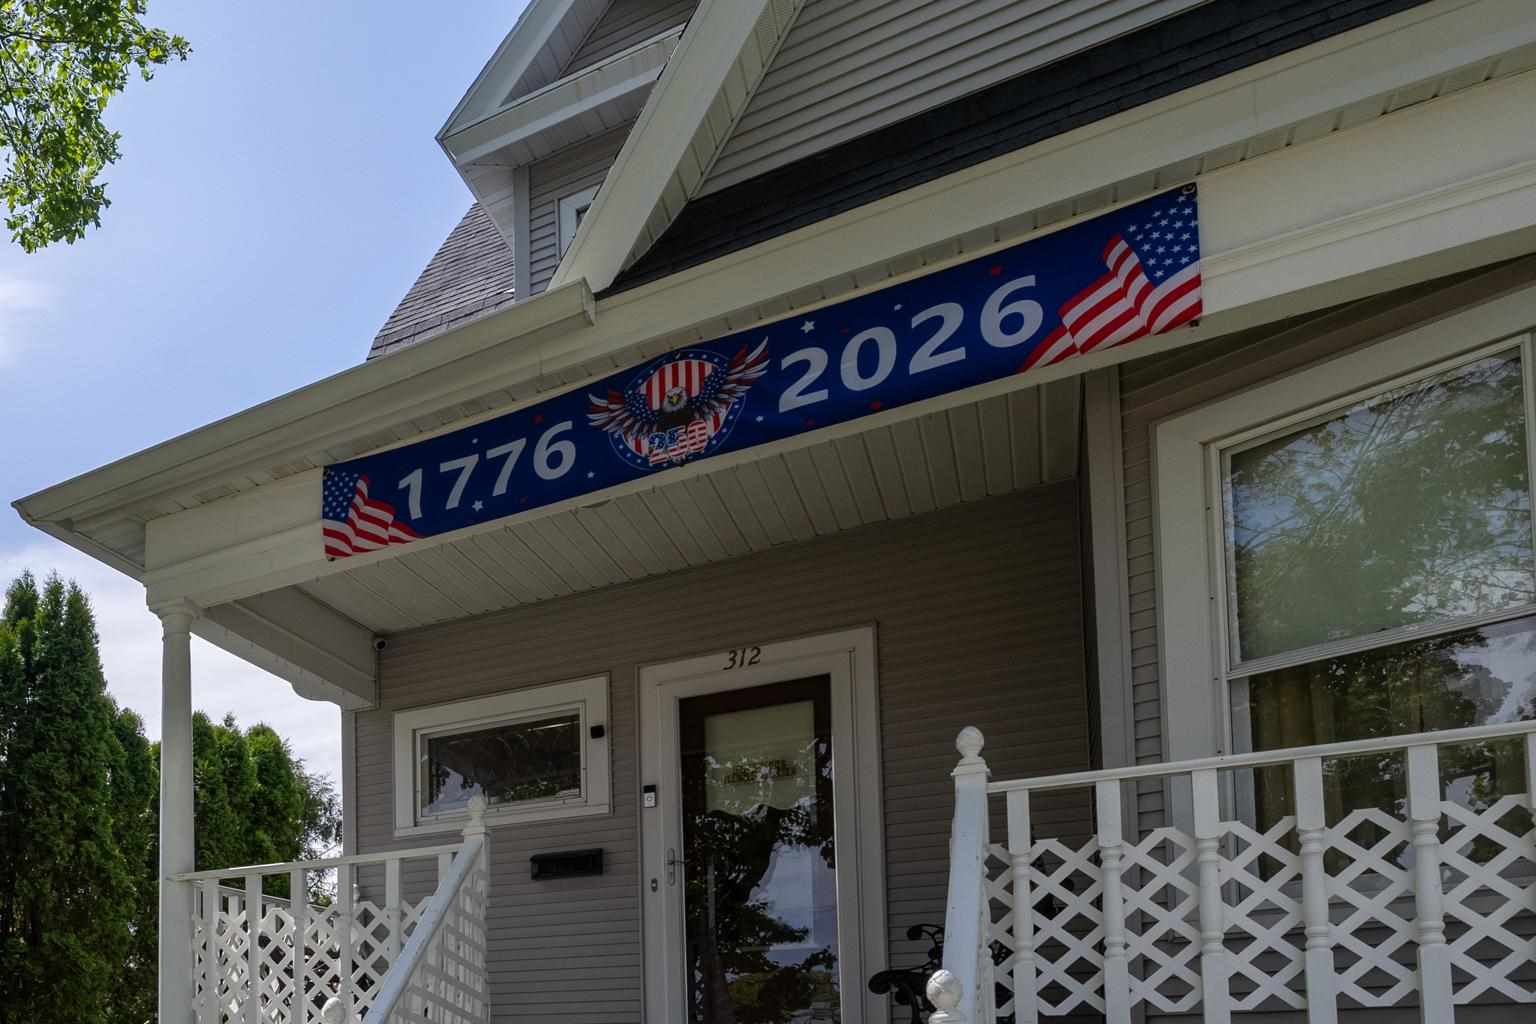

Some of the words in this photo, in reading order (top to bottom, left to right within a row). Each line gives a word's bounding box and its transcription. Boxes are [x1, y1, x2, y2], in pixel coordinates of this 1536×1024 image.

[398, 421, 576, 520] 1776
[779, 275, 1044, 413] 2026
[648, 420, 707, 464] 250
[723, 646, 761, 670] 312
